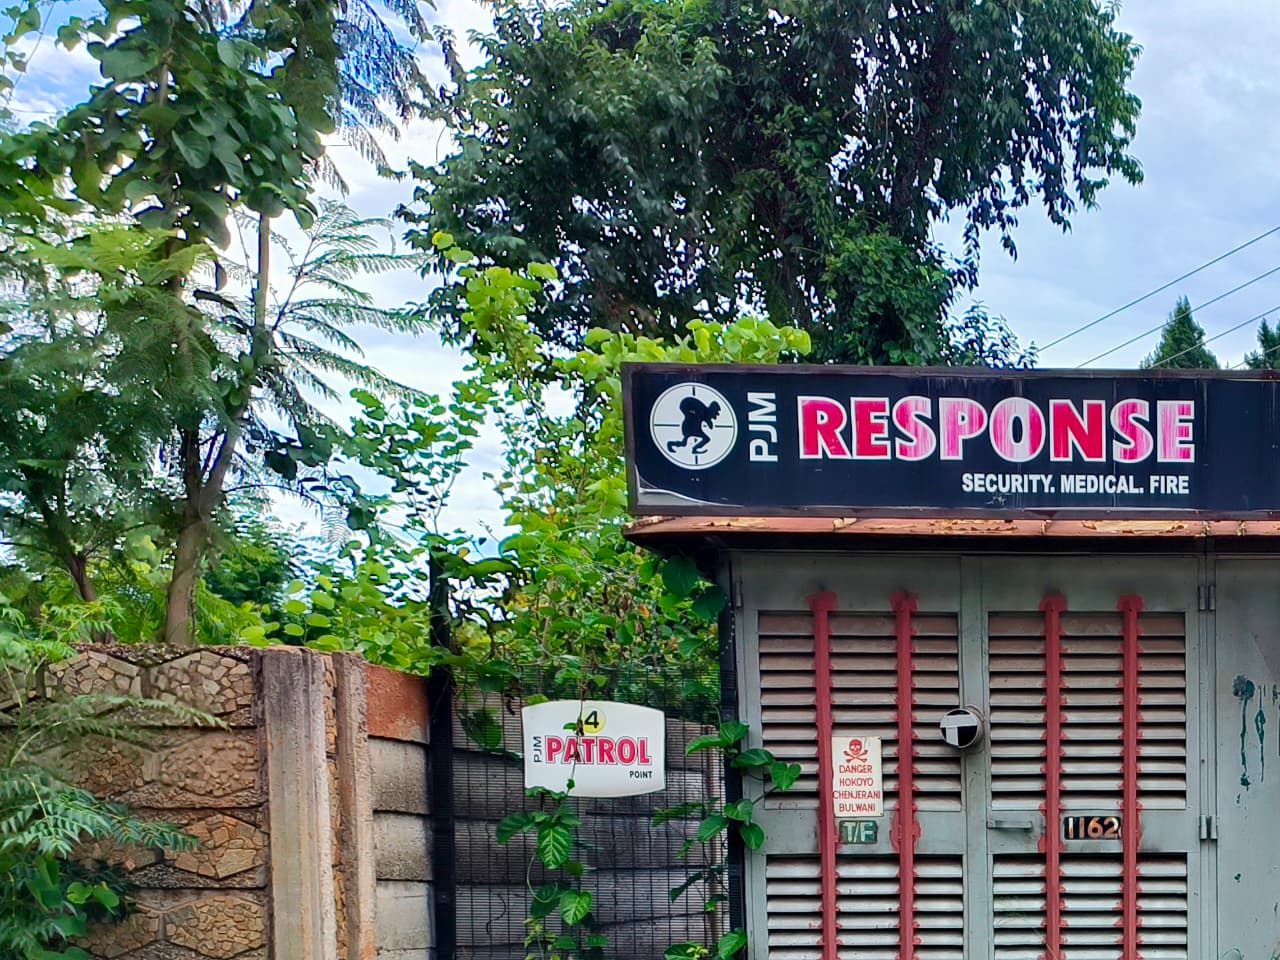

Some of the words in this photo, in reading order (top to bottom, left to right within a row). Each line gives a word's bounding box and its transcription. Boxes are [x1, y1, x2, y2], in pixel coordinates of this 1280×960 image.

[748, 392, 778, 463] PJM
[797, 396, 1195, 464] RESPONSE
[961, 473, 1056, 495] SECURITY.
[1059, 474, 1145, 495] MEDICAL.
[1149, 475, 1190, 494] FIRE
[584, 710, 600, 728] 4
[533, 736, 542, 762] PJM
[545, 735, 652, 766] PATROL
[629, 771, 653, 779] POINT
[839, 765, 873, 774] DANGER
[839, 778, 874, 787] HOKOYO
[833, 790, 881, 800] CHENJERANI
[839, 803, 876, 812] BULWANI
[1068, 817, 1121, 839] 1162
